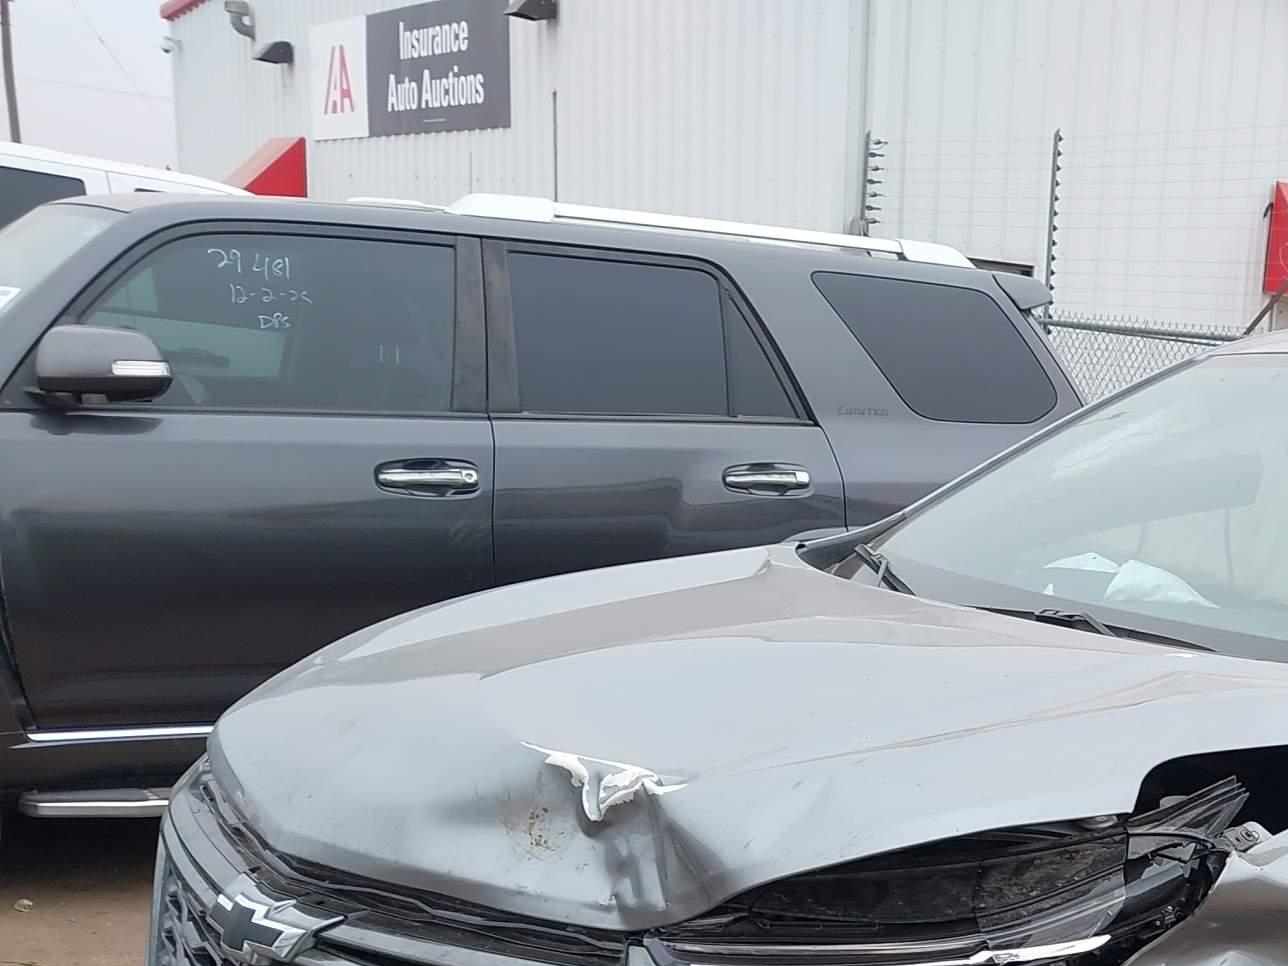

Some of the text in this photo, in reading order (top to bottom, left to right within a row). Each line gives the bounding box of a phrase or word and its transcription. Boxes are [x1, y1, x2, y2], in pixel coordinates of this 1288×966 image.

[399, 21, 468, 60] Insurance
[387, 66, 484, 112] Auto Auctions
